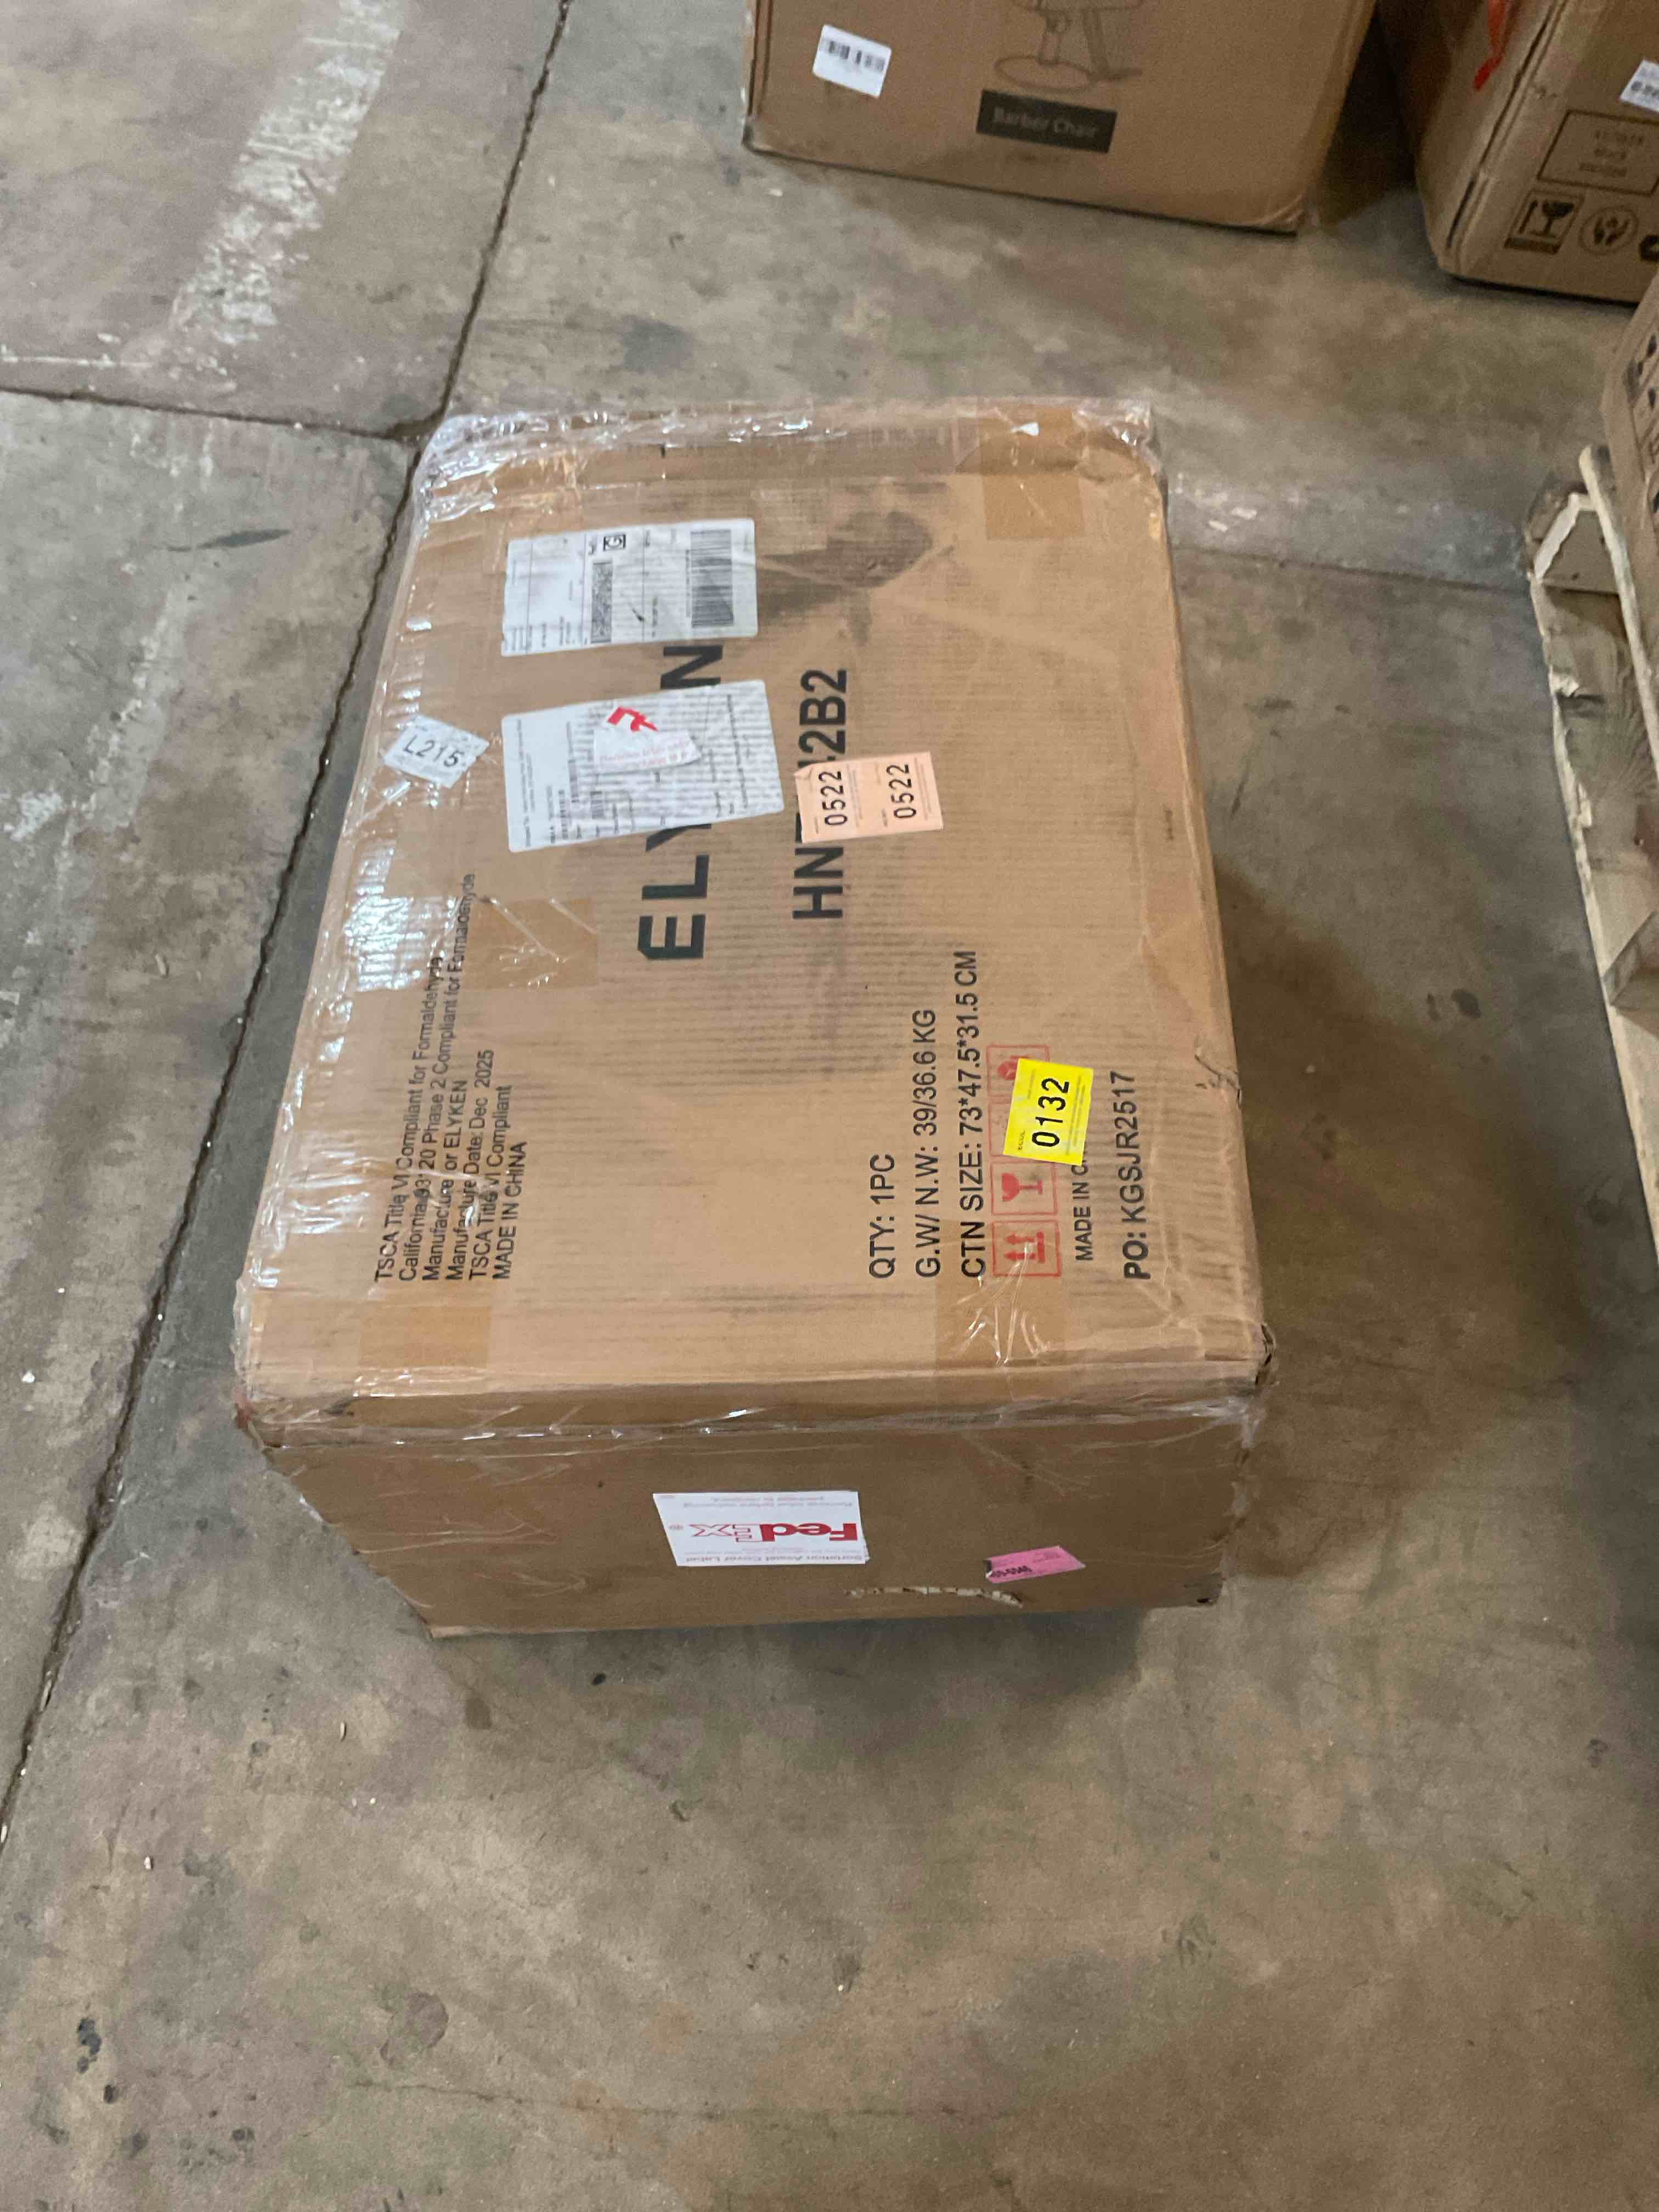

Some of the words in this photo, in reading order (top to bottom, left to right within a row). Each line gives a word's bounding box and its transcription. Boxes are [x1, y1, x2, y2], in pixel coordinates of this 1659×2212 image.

[638, 645, 724, 960] ELYN
[793, 668, 847, 919] HN2B2
[818, 771, 848, 825] 0522
[886, 764, 916, 819] 0522
[445, 977, 460, 995] for
[954, 951, 977, 986] CM
[432, 1001, 456, 1074] Compliant
[912, 1010, 936, 1043] KG
[409, 1066, 426, 1085] for
[430, 1079, 445, 1088] 2
[474, 1049, 494, 1088] 2025
[912, 1051, 938, 1136] 39/36.6
[396, 1090, 424, 1169] Compliant
[422, 1094, 444, 1143] Phase
[444, 1080, 467, 1148] ELYKEN
[487, 1085, 511, 1167] Compliant
[1032, 1078, 1069, 1147] 0132
[445, 1154, 458, 1172] or
[505, 1142, 527, 1197] CHINA
[1111, 1071, 1147, 1223] KGSJR2517
[392, 1175, 410, 1190] VI
[870, 1154, 895, 1205] 1PC
[915, 1147, 939, 1205] N.W:
[958, 1143, 984, 1211] SIZE:
[1073, 1182, 1089, 1199] IN
[384, 1195, 407, 1228] Title
[477, 1192, 498, 1226] Title
[502, 1204, 519, 1220] IN
[1074, 1206, 1094, 1261] MADE
[374, 1232, 399, 1282] TSCA
[399, 1201, 427, 1281] California
[469, 1229, 493, 1280] TSCA
[493, 1226, 516, 1279] MADE
[869, 1216, 895, 1278] QTY:
[915, 1214, 940, 1277] G.W/
[960, 1221, 985, 1277] CTN
[1123, 1232, 1150, 1280] PO:
[689, 1523, 857, 1542] FedEx
